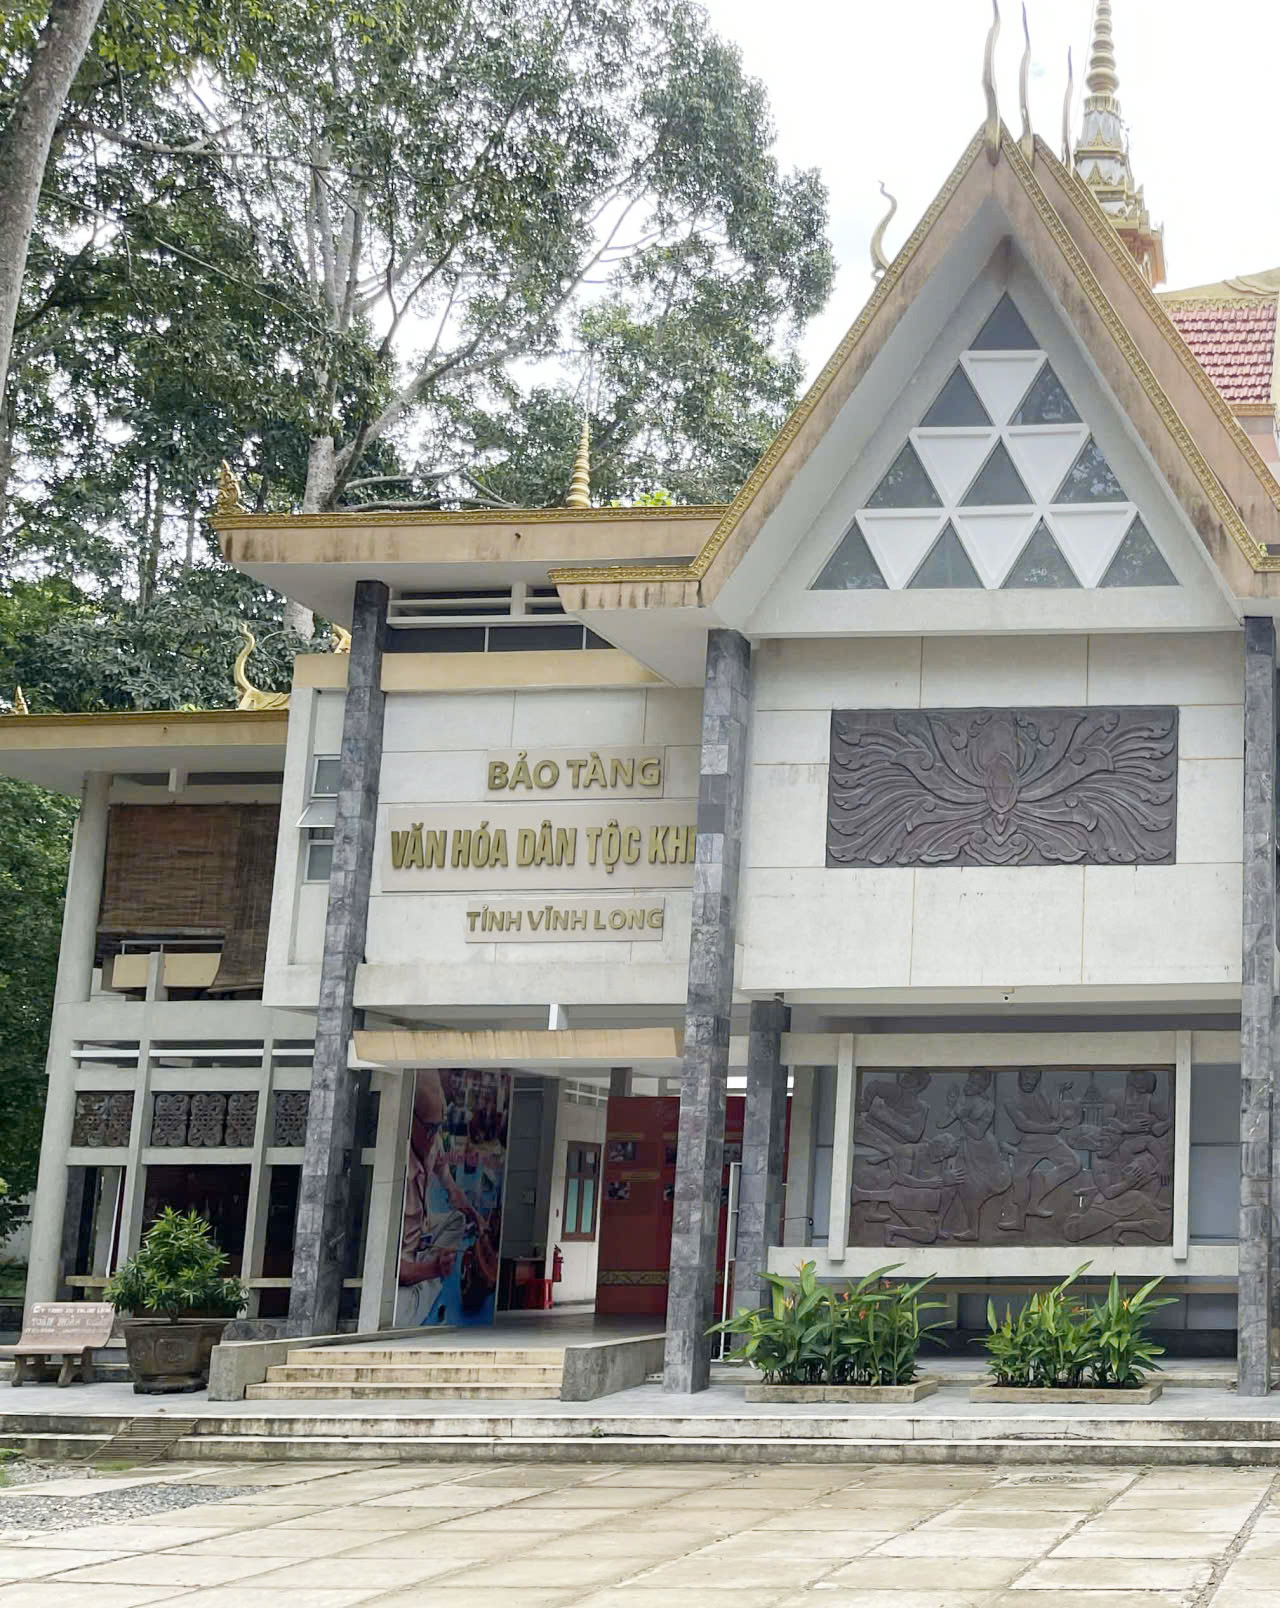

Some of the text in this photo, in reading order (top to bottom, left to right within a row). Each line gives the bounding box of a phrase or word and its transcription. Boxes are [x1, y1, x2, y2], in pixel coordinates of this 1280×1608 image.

[488, 751, 661, 790] BẢO TÀNG
[391, 822, 447, 868] VĂN
[451, 821, 508, 867] HÓA
[517, 820, 577, 866] DÂN
[586, 819, 641, 874] TỘC
[467, 904, 664, 932] TỈNH VĨNH LONG
